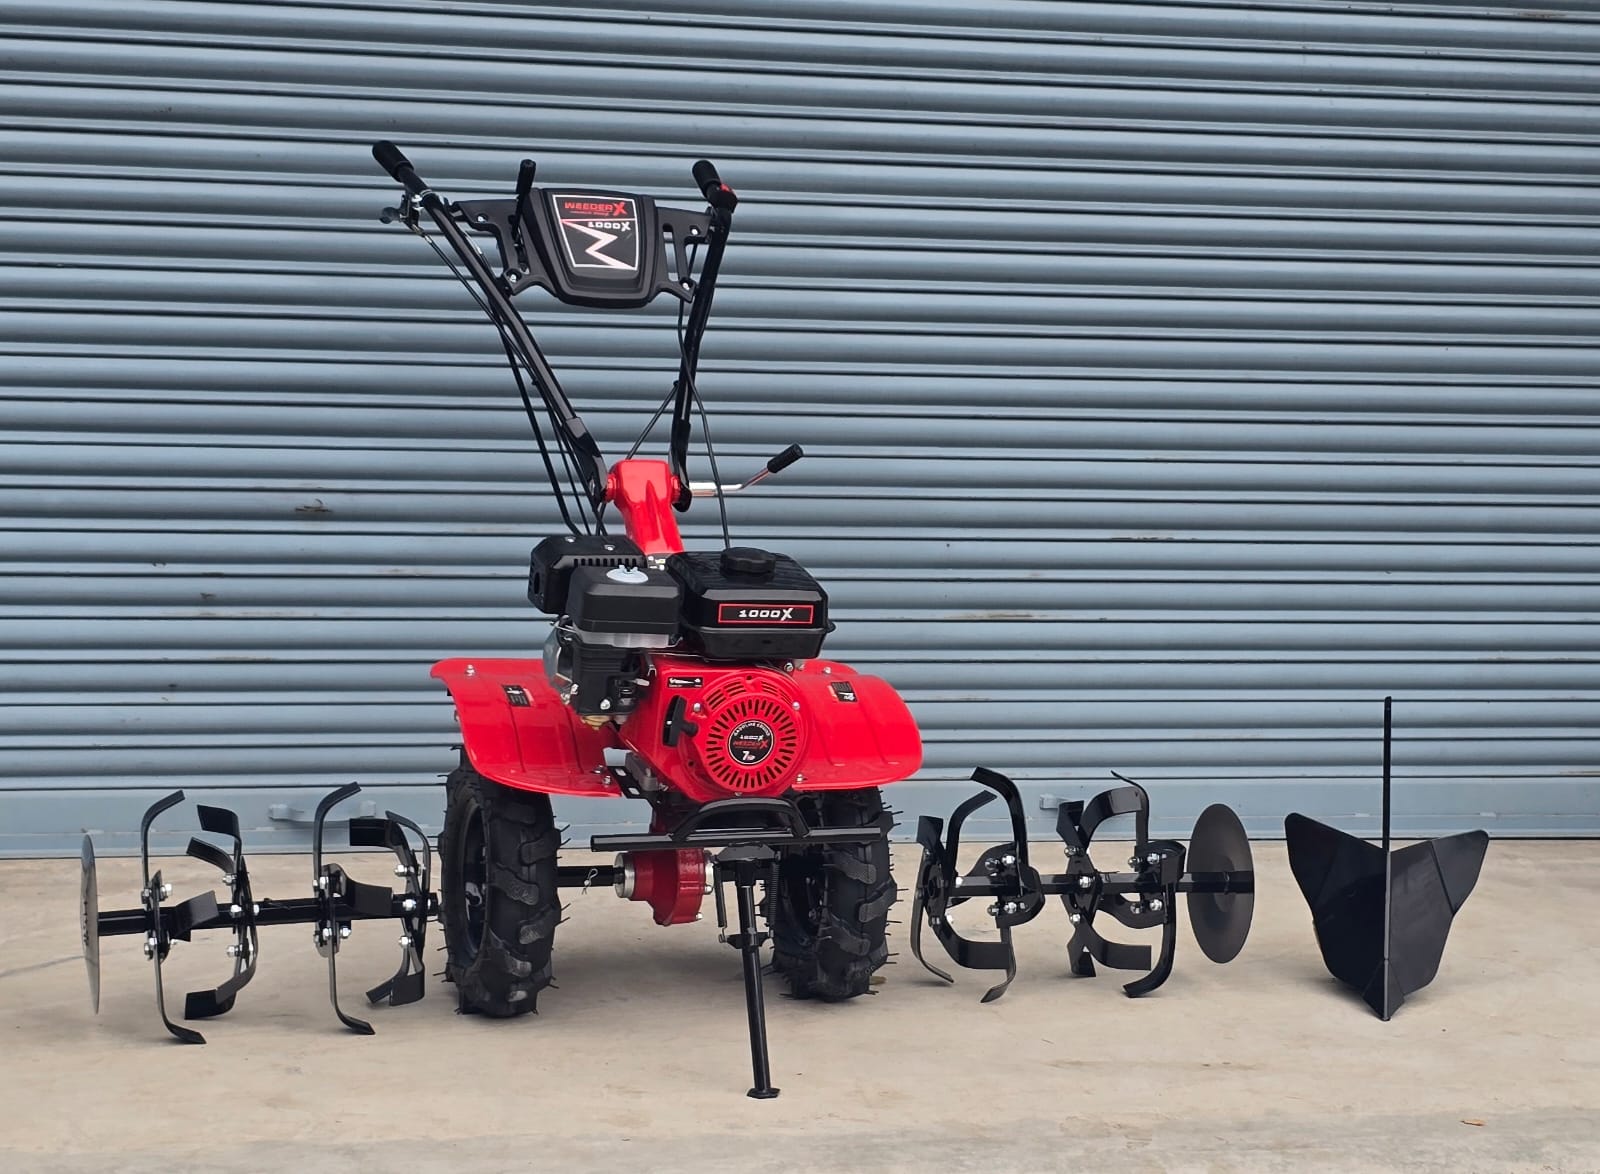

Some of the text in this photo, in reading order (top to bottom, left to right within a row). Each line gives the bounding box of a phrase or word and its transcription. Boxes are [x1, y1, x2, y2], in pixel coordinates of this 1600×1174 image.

[564, 201, 627, 216] WEEDERX
[587, 221, 631, 232] 1000X
[738, 607, 794, 622] 1000X
